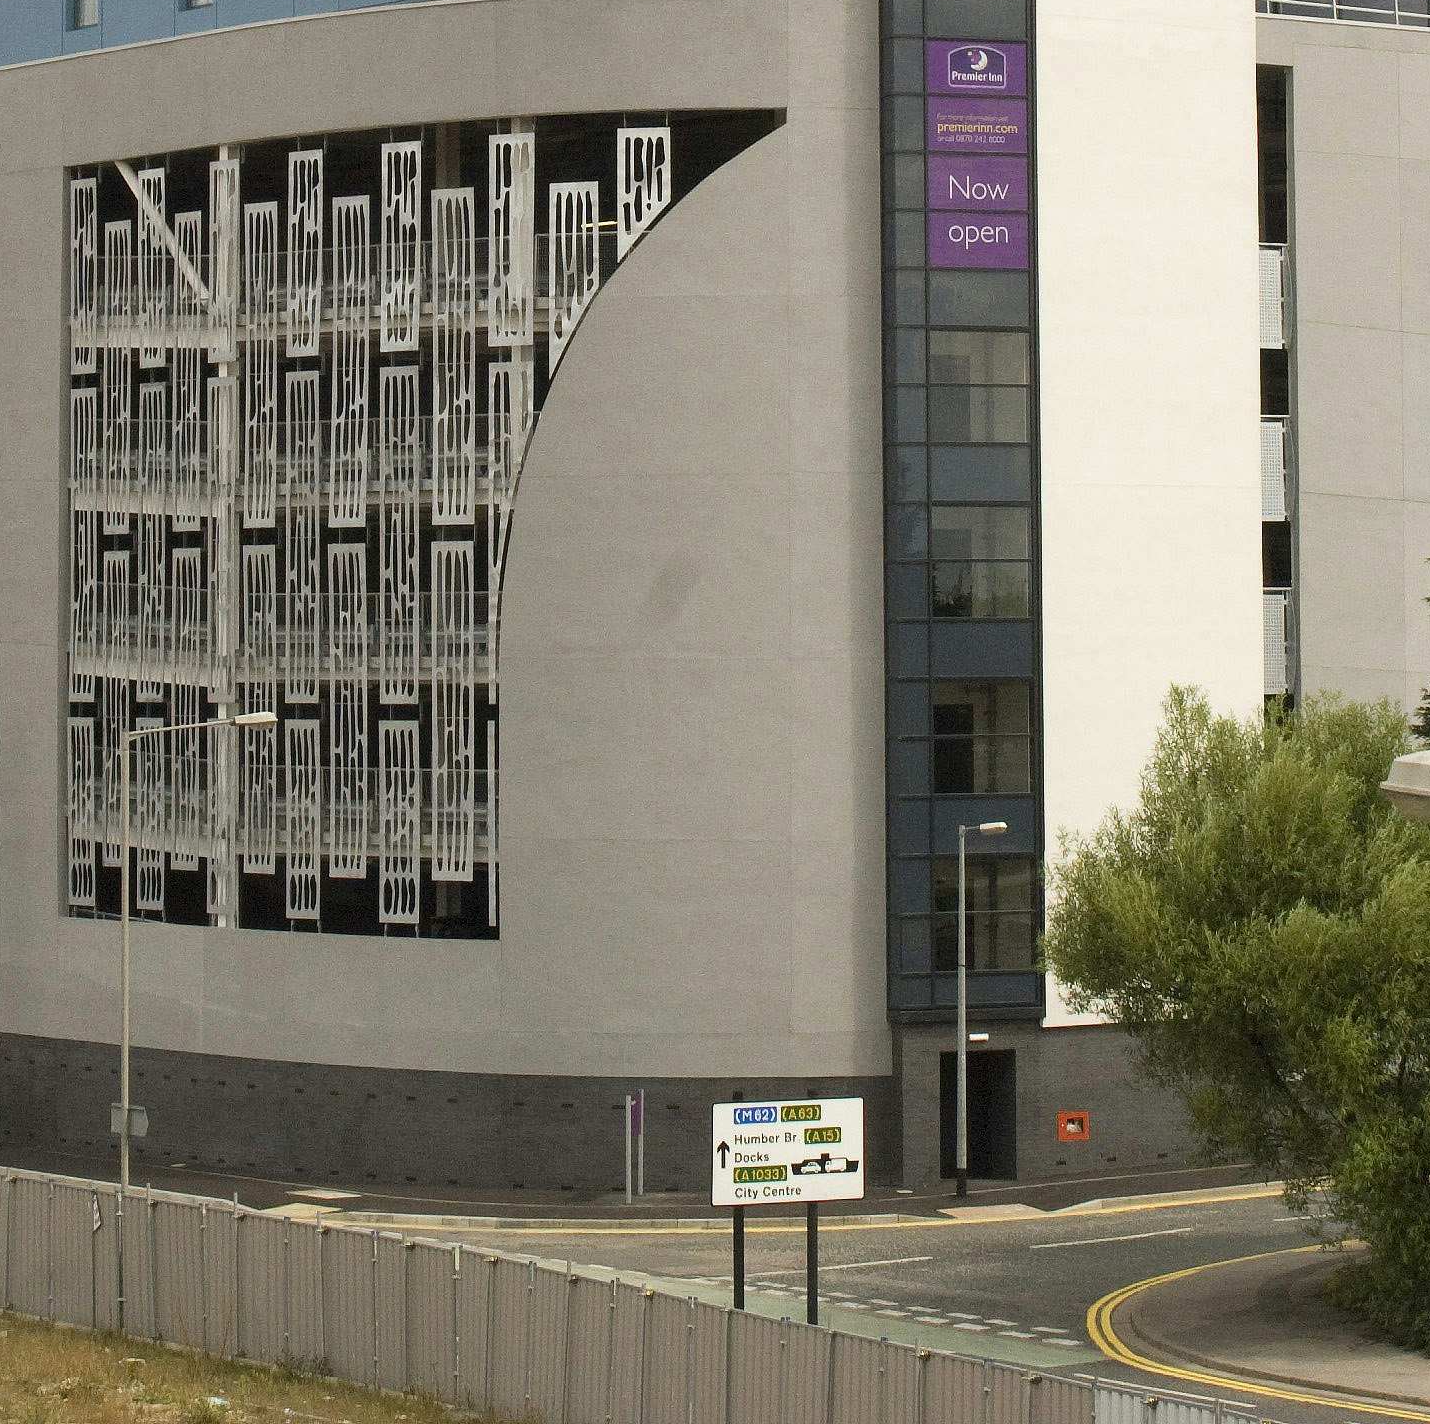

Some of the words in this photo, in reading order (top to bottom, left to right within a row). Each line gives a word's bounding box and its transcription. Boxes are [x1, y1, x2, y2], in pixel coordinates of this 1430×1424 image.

[952, 71, 987, 82] Premier
[988, 72, 1003, 83] Inn
[937, 122, 1018, 134] premierinn.com
[949, 175, 1009, 200] Now
[948, 224, 1009, 250] open
[735, 1132, 779, 1144] Humber
[735, 1152, 770, 1163] Docks
[735, 1187, 759, 1200] City
[763, 1186, 802, 1197] Centre
